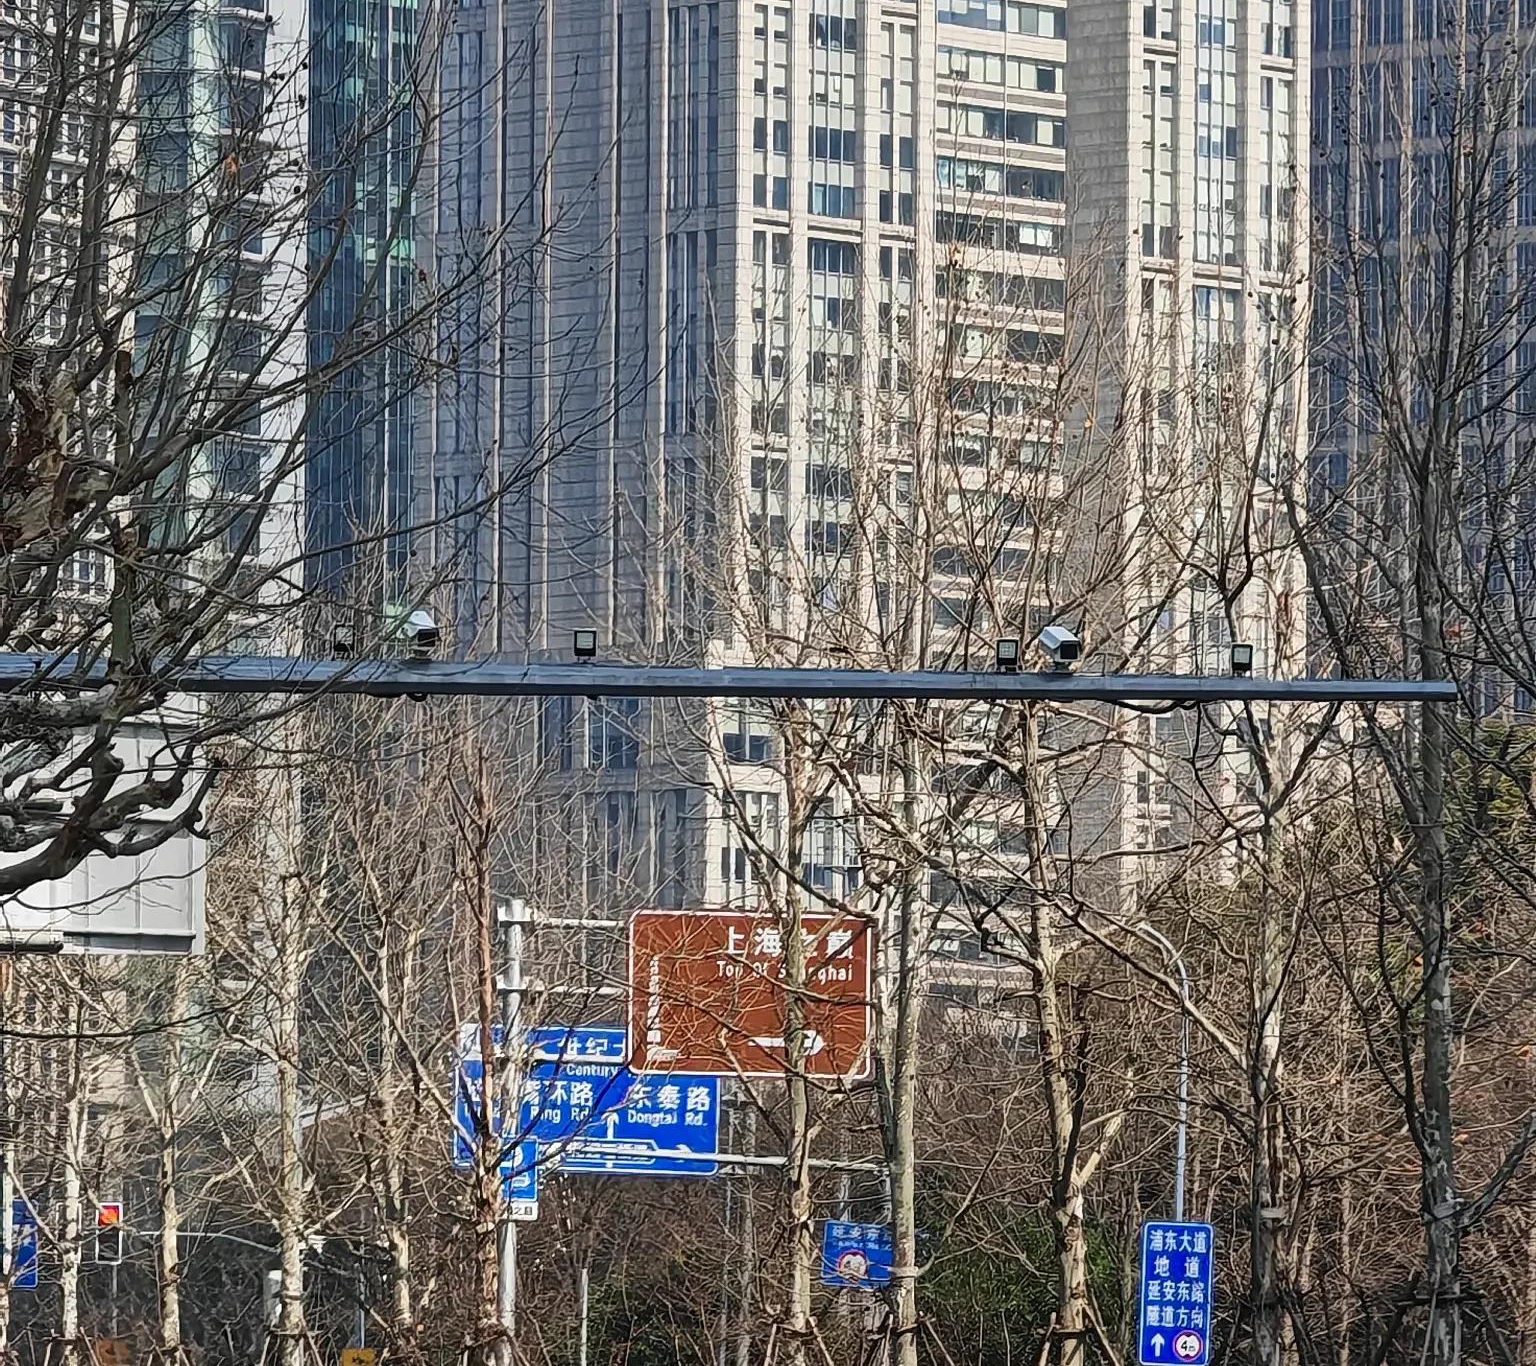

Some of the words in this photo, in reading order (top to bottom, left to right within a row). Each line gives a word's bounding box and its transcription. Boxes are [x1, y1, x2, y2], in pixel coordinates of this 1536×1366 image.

[778, 963, 853, 985] Snghai
[566, 1064, 619, 1078] Century
[628, 1109, 678, 1126] Dongtai
[684, 1112, 708, 1126] Rd.
[1149, 1229, 1208, 1254] 浦东大道
[1147, 1280, 1205, 1304] 延安东路
[1146, 1305, 1204, 1329] 隧道方向
